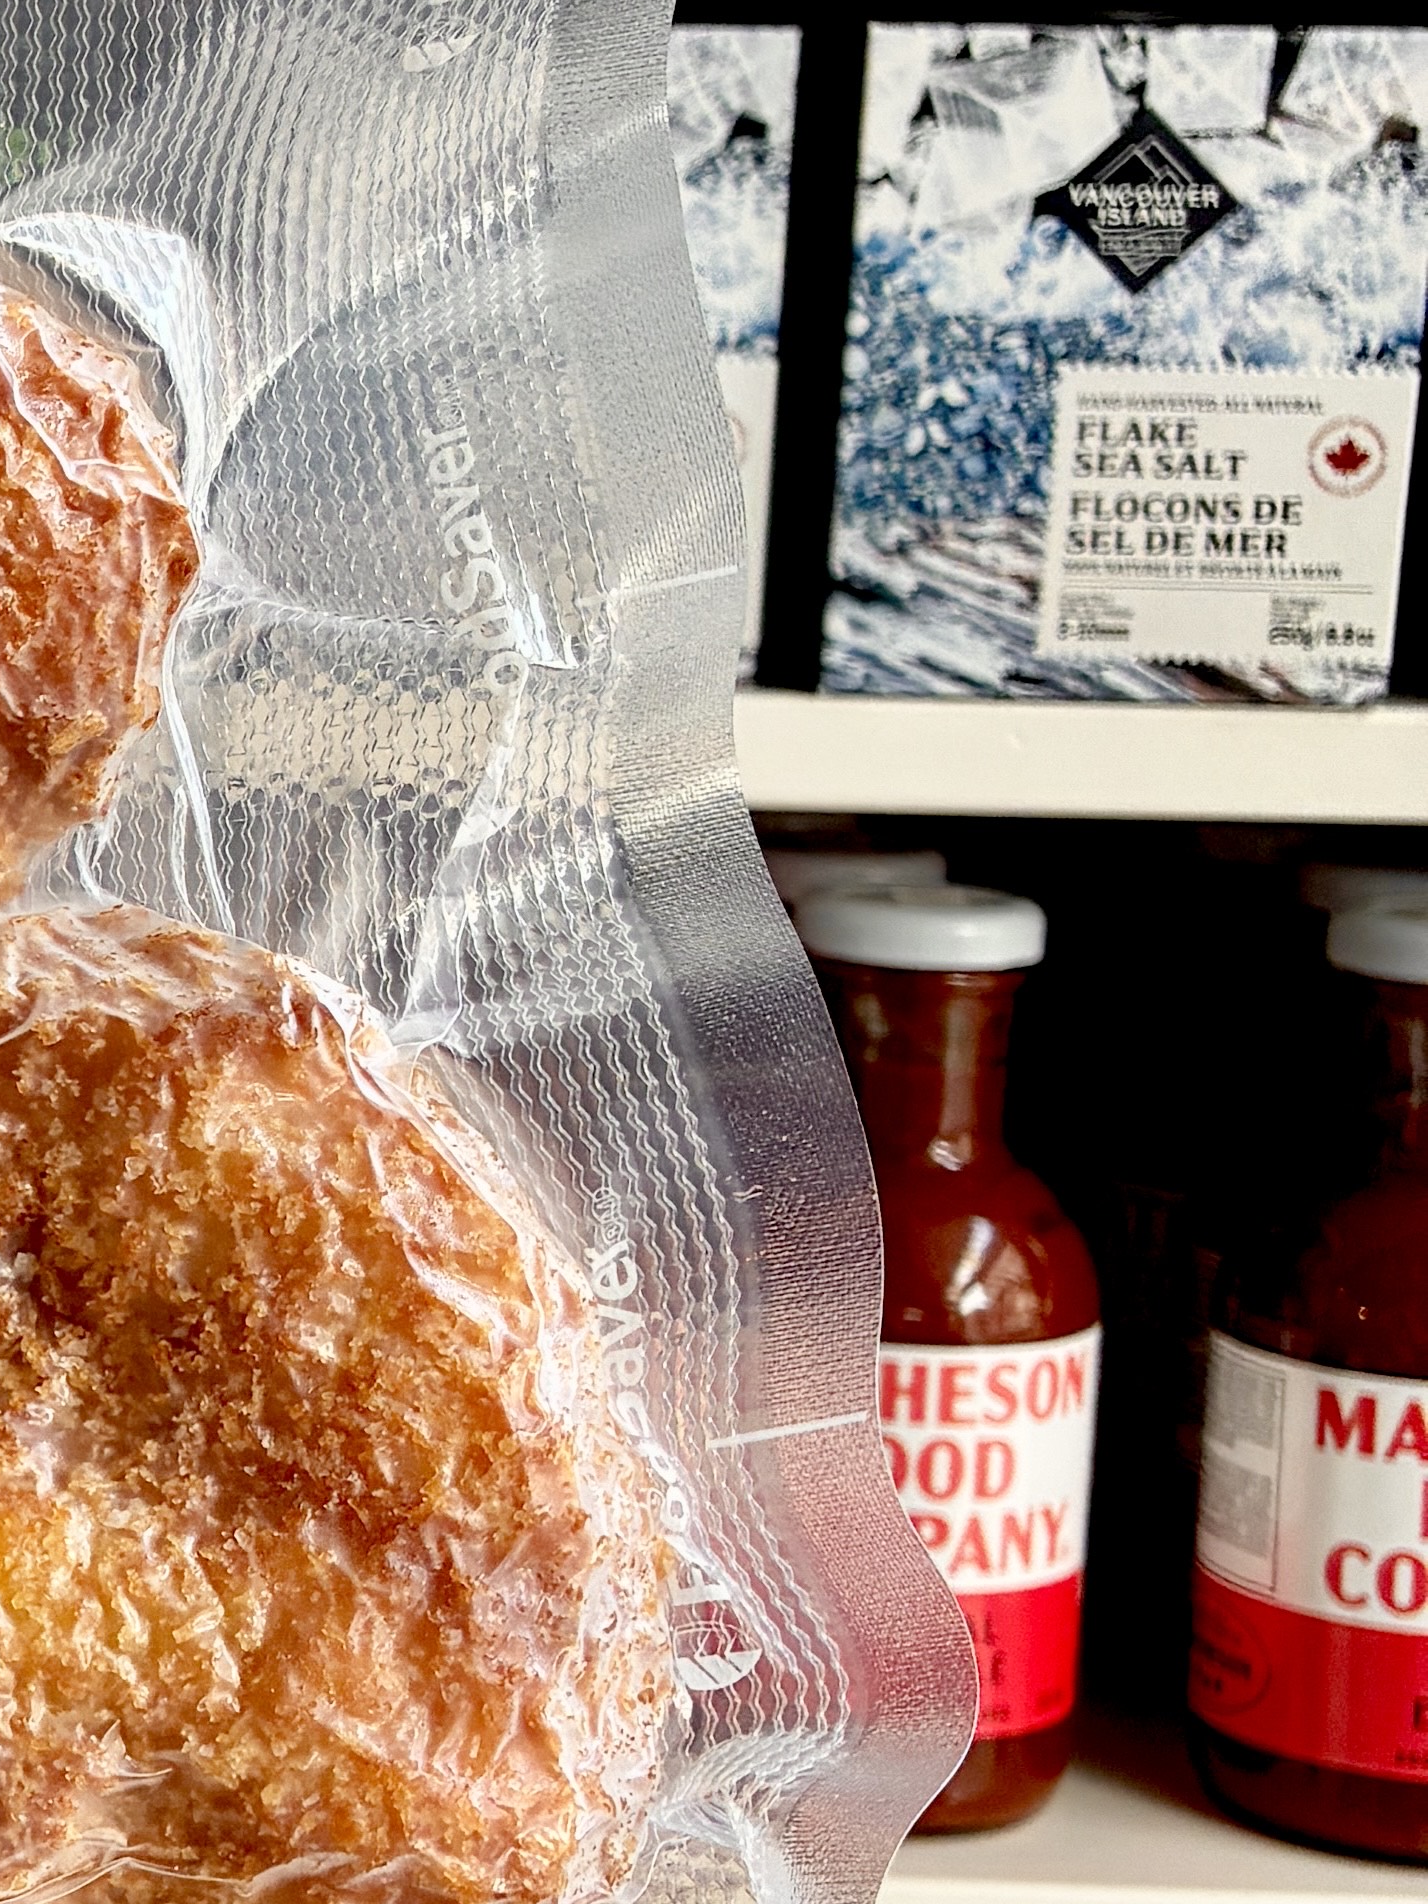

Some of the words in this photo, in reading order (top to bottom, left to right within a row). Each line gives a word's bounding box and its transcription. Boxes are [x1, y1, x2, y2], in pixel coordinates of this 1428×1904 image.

[1068, 183, 1221, 209] VANCOUVER
[1097, 206, 1187, 228] ISLAND
[1075, 416, 1198, 448] FLAKE
[1072, 450, 1146, 481] SEA
[1152, 451, 1247, 482] SALT
[1069, 491, 1244, 524] FLOCONS
[1252, 493, 1304, 527] DE
[1064, 523, 1136, 556] SEL
[1144, 526, 1196, 557] DE
[1202, 528, 1288, 559] MER
